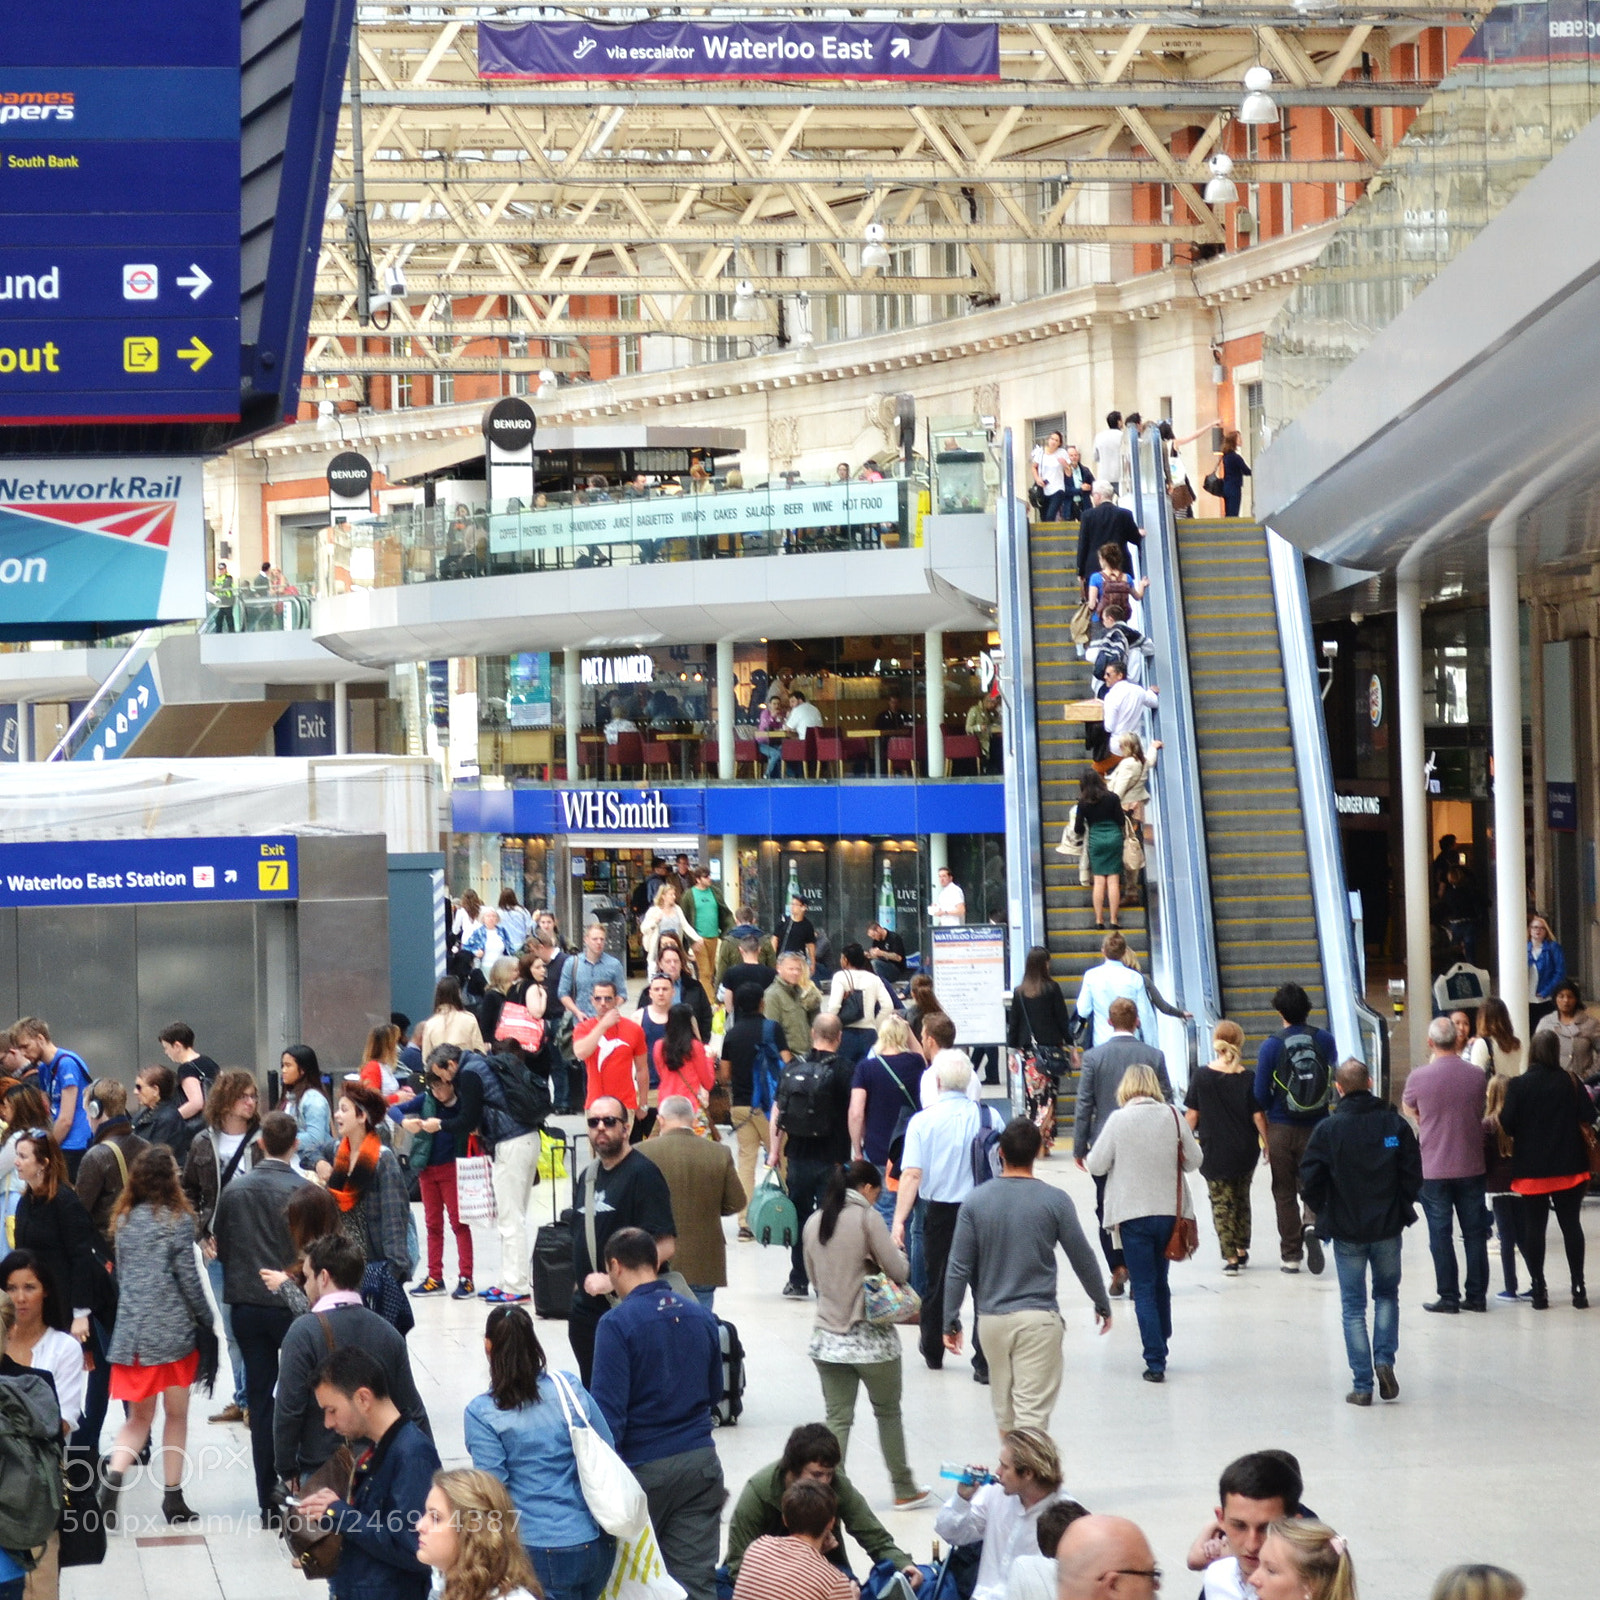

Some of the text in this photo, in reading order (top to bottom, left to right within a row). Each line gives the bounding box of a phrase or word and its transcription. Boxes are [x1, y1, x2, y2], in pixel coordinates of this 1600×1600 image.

[606, 35, 874, 60] via escalator Waterloo East
[8, 154, 79, 168] South Bank
[0, 265, 60, 299] und
[0, 341, 60, 373] out
[493, 419, 532, 430] BENUGO
[331, 470, 368, 479] BENUGO
[552, 523, 563, 534] TEA
[569, 519, 607, 533] SANDWICHES
[613, 517, 631, 529] JUICE
[637, 512, 675, 527] BAGUETTES
[681, 511, 706, 523] WRAPS
[713, 508, 738, 520] CAKES
[745, 504, 776, 518] SALADS
[783, 502, 804, 514] BEER
[812, 500, 834, 513] WINE
[842, 499, 858, 511] HOT
[860, 497, 883, 509] FOOD
[0, 556, 48, 584] on
[604, 657, 613, 684] A
[298, 716, 327, 739] Exit
[561, 790, 670, 830] WHSmith
[1338, 795, 1380, 815] BURGER KING
[260, 844, 285, 856] Exit
[7, 870, 186, 891] Waterloo East Station
[266, 865, 282, 886] 7
[803, 889, 823, 899] LIVE
[896, 889, 917, 900] LIVE
